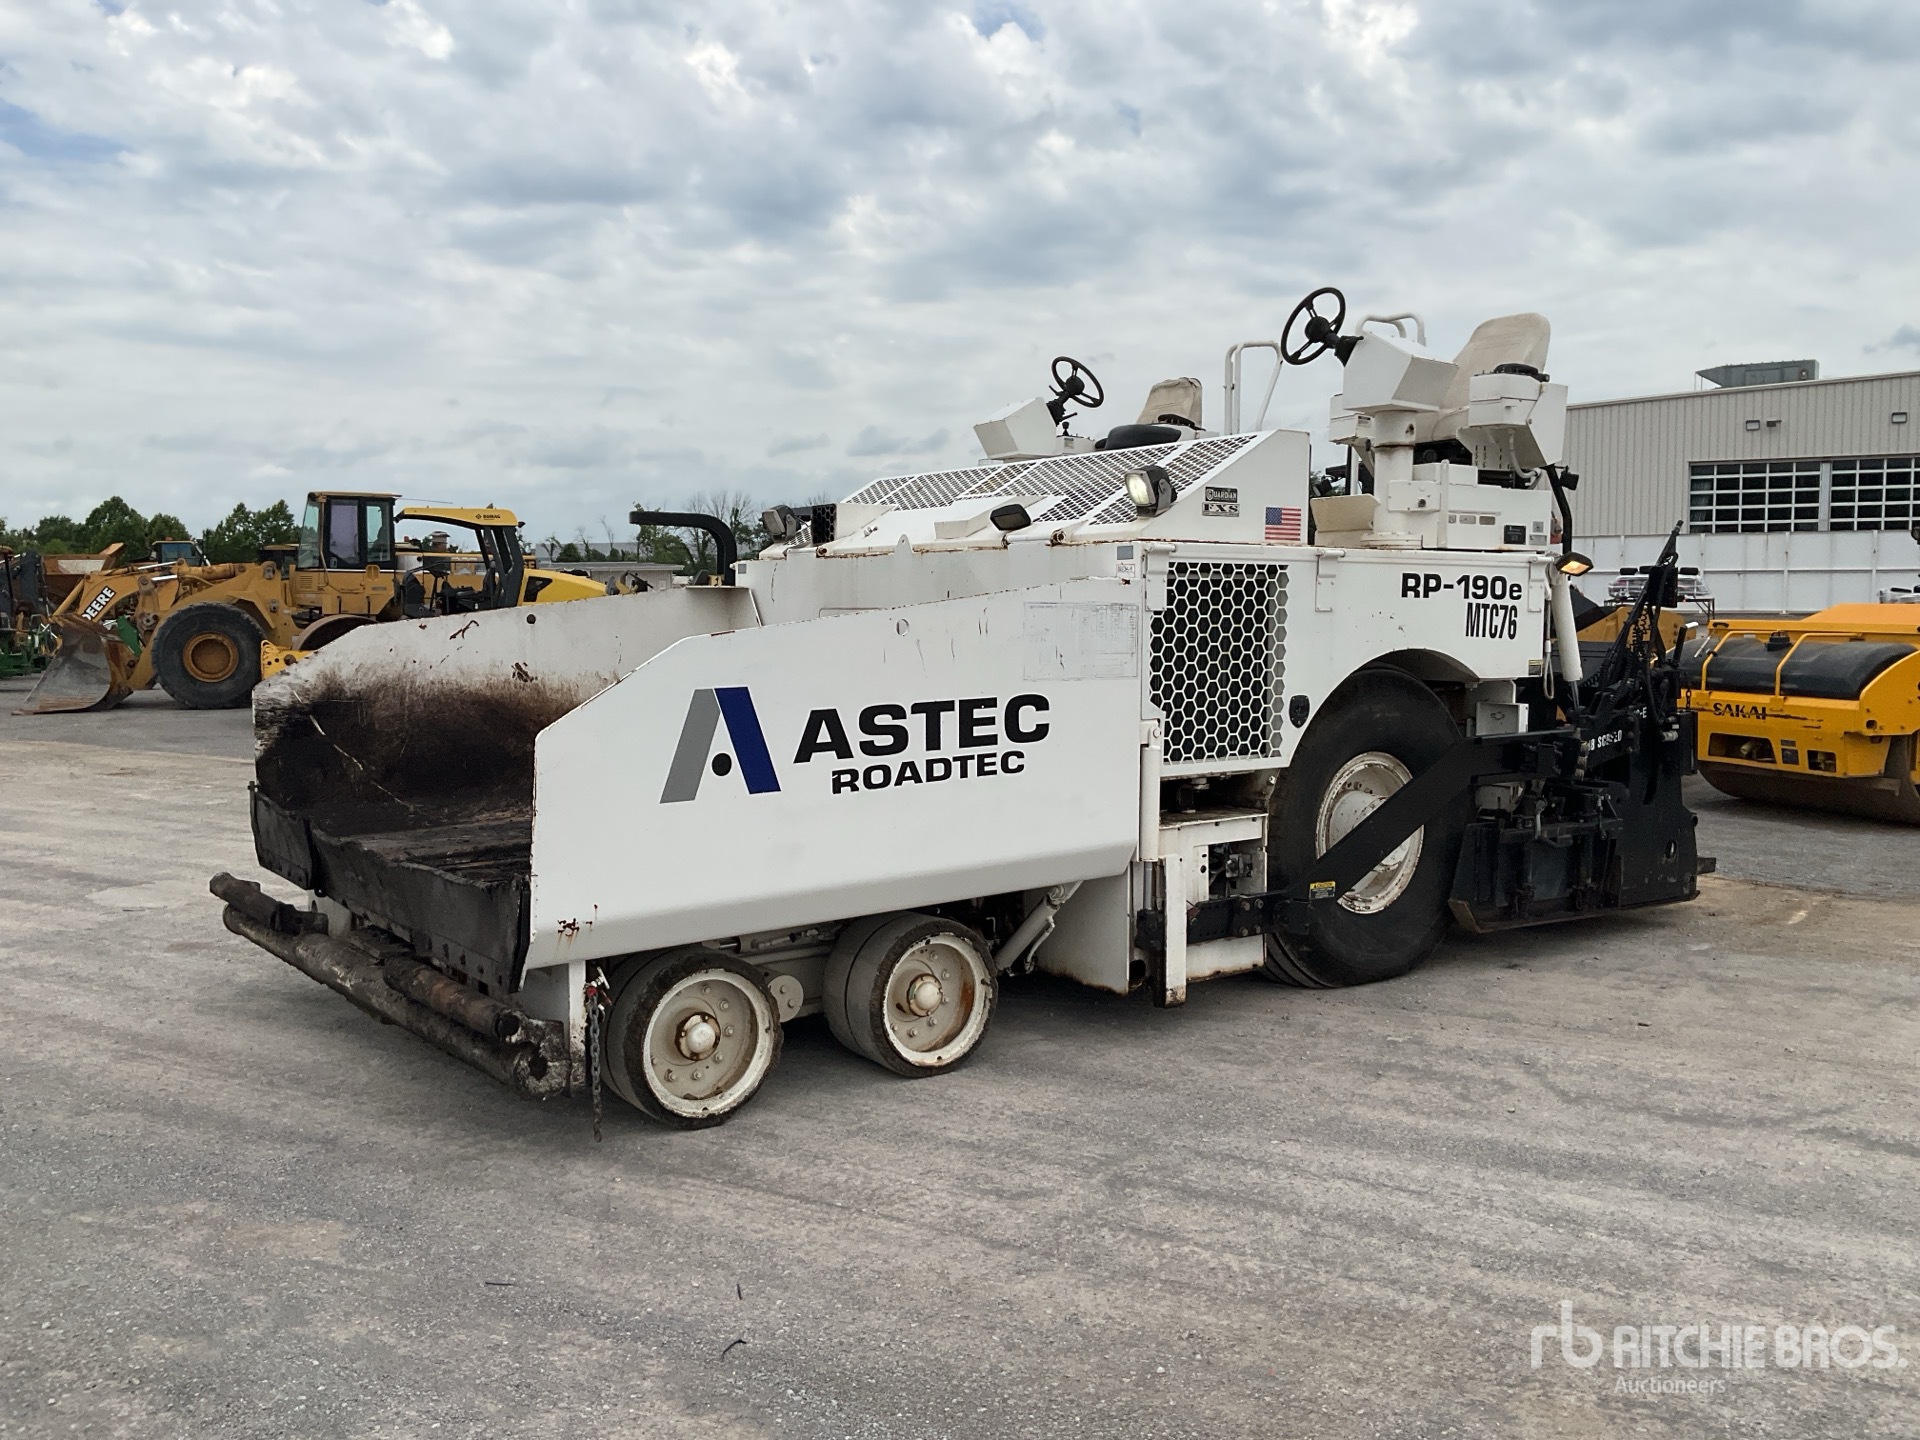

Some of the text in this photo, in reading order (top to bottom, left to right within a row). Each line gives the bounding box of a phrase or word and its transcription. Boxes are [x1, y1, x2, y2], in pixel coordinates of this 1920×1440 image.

[1401, 572, 1523, 601] RP-190e
[1465, 602, 1519, 641] MTC76
[793, 694, 1051, 764] ASTEC
[1712, 702, 1767, 720] SAKAI
[832, 750, 1025, 794] ROADTEC
